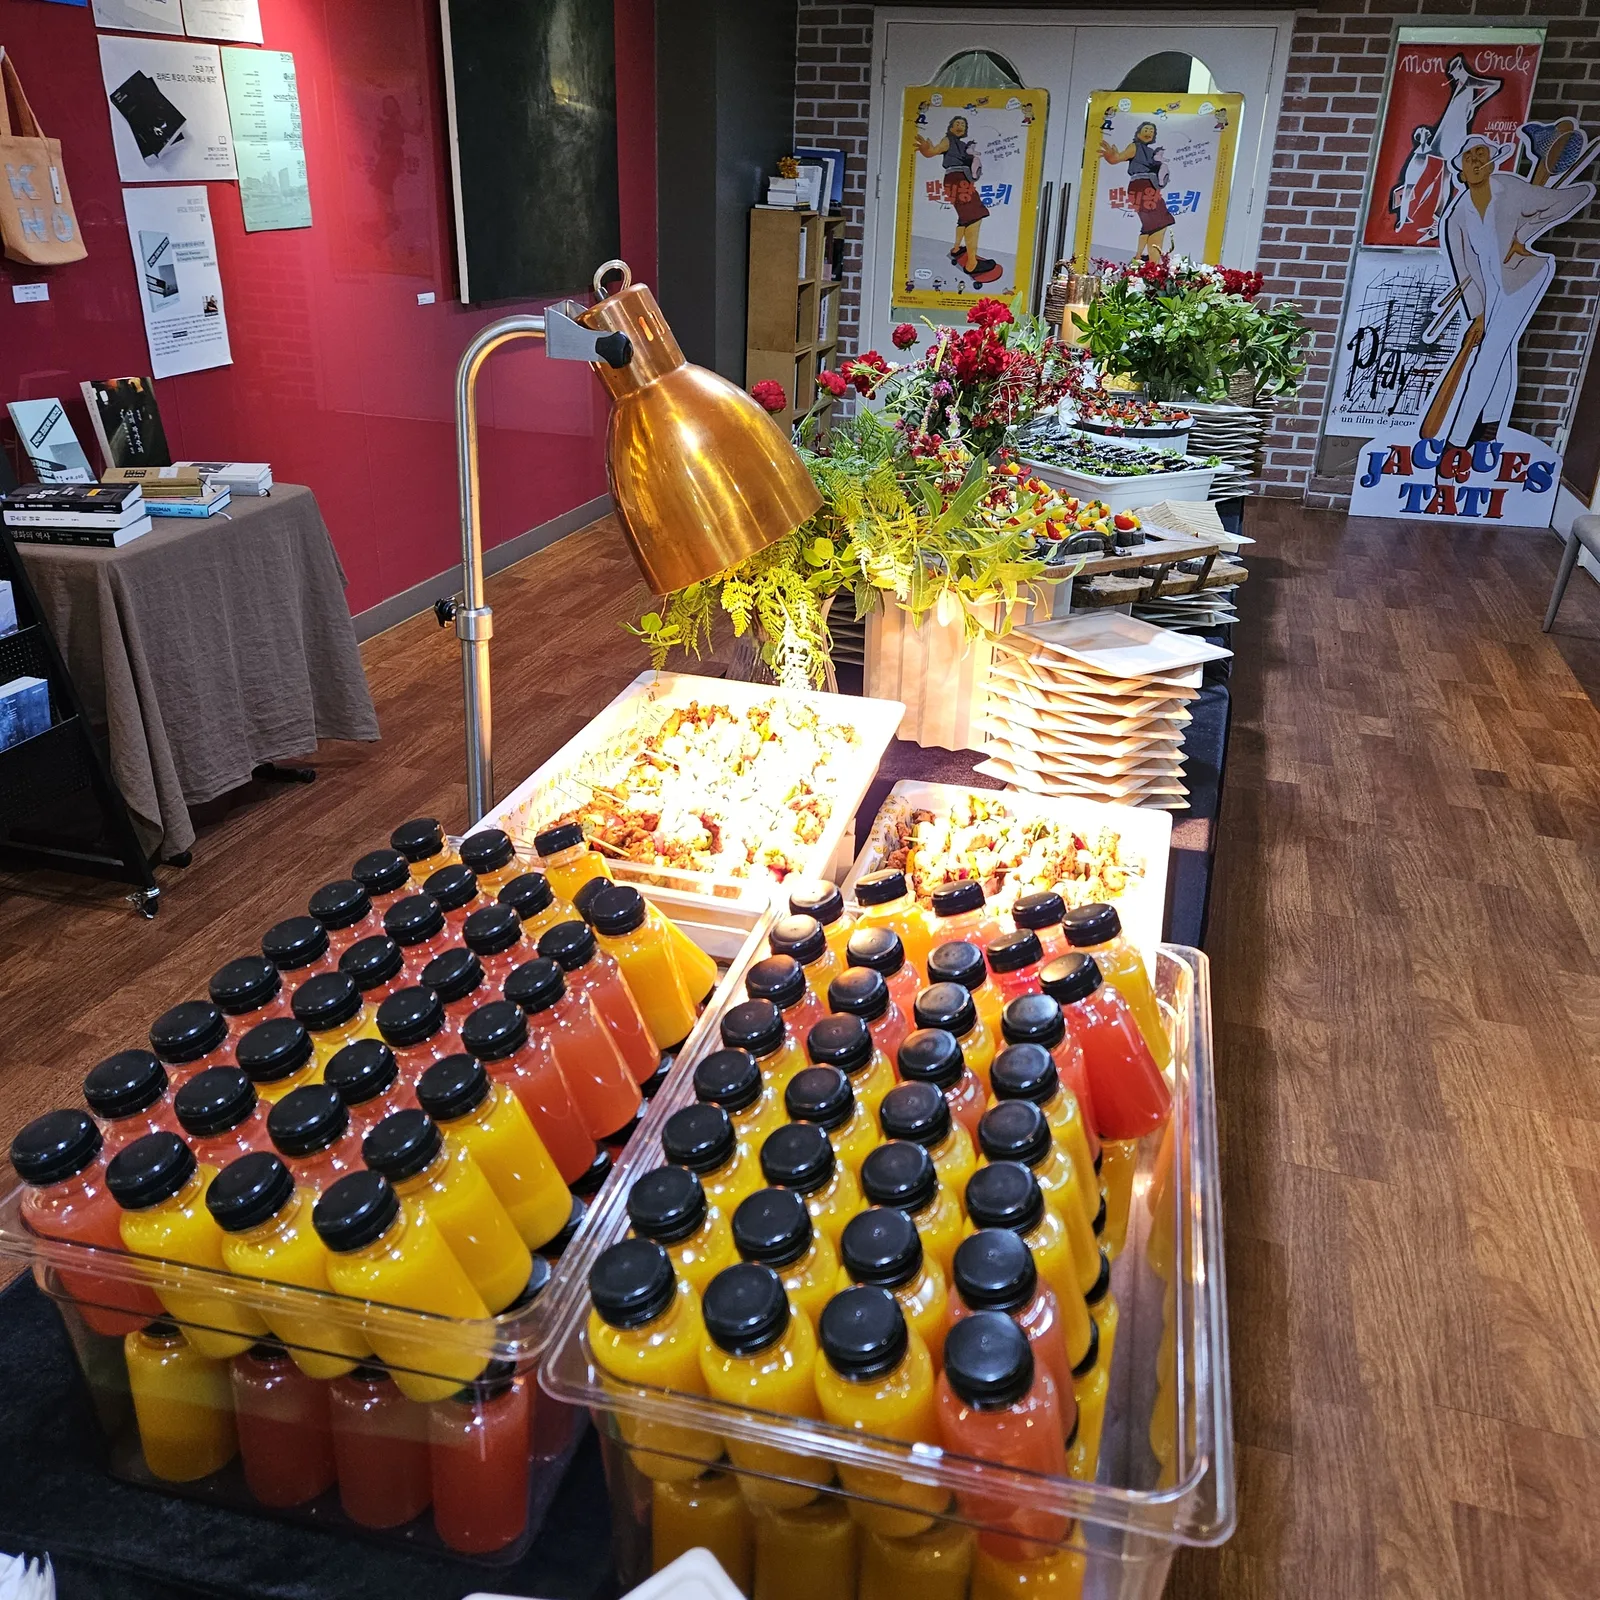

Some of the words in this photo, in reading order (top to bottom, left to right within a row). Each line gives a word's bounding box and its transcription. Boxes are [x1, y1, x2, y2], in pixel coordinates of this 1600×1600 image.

[1484, 121, 1518, 132] JACQUES
[980, 183, 1012, 205] 몽키
[1166, 190, 1201, 213] 몽키
[1355, 415, 1374, 424] film
[1376, 416, 1388, 425] de
[1360, 438, 1556, 493] JACQUES
[1398, 482, 1509, 519] TATI
